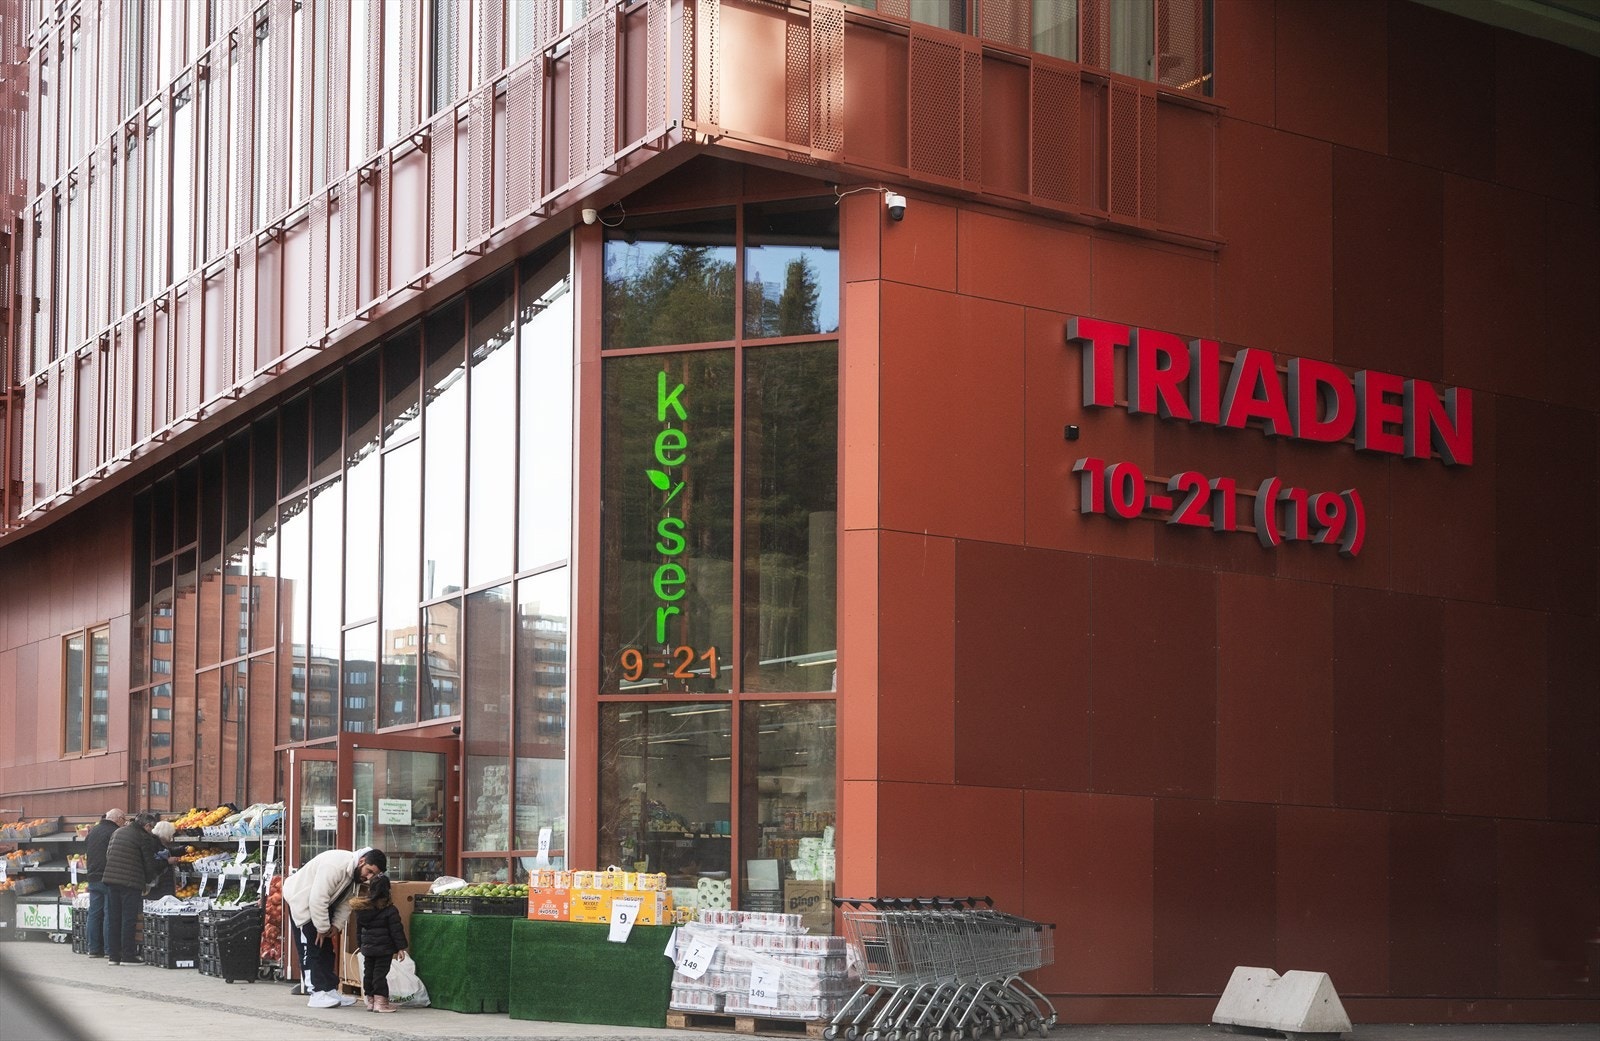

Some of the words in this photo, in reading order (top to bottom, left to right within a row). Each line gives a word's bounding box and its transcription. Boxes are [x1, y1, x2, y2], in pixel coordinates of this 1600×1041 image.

[1067, 316, 1474, 466] TRIADEN
[1072, 457, 1236, 532] 10-21
[1254, 476, 1366, 557] (19)
[789, 895, 820, 910] Bingo
[619, 912, 627, 924] 9
[693, 948, 700, 956] 7
[682, 959, 698, 970] 149
[757, 976, 763, 984] 7
[751, 989, 765, 998] 149
